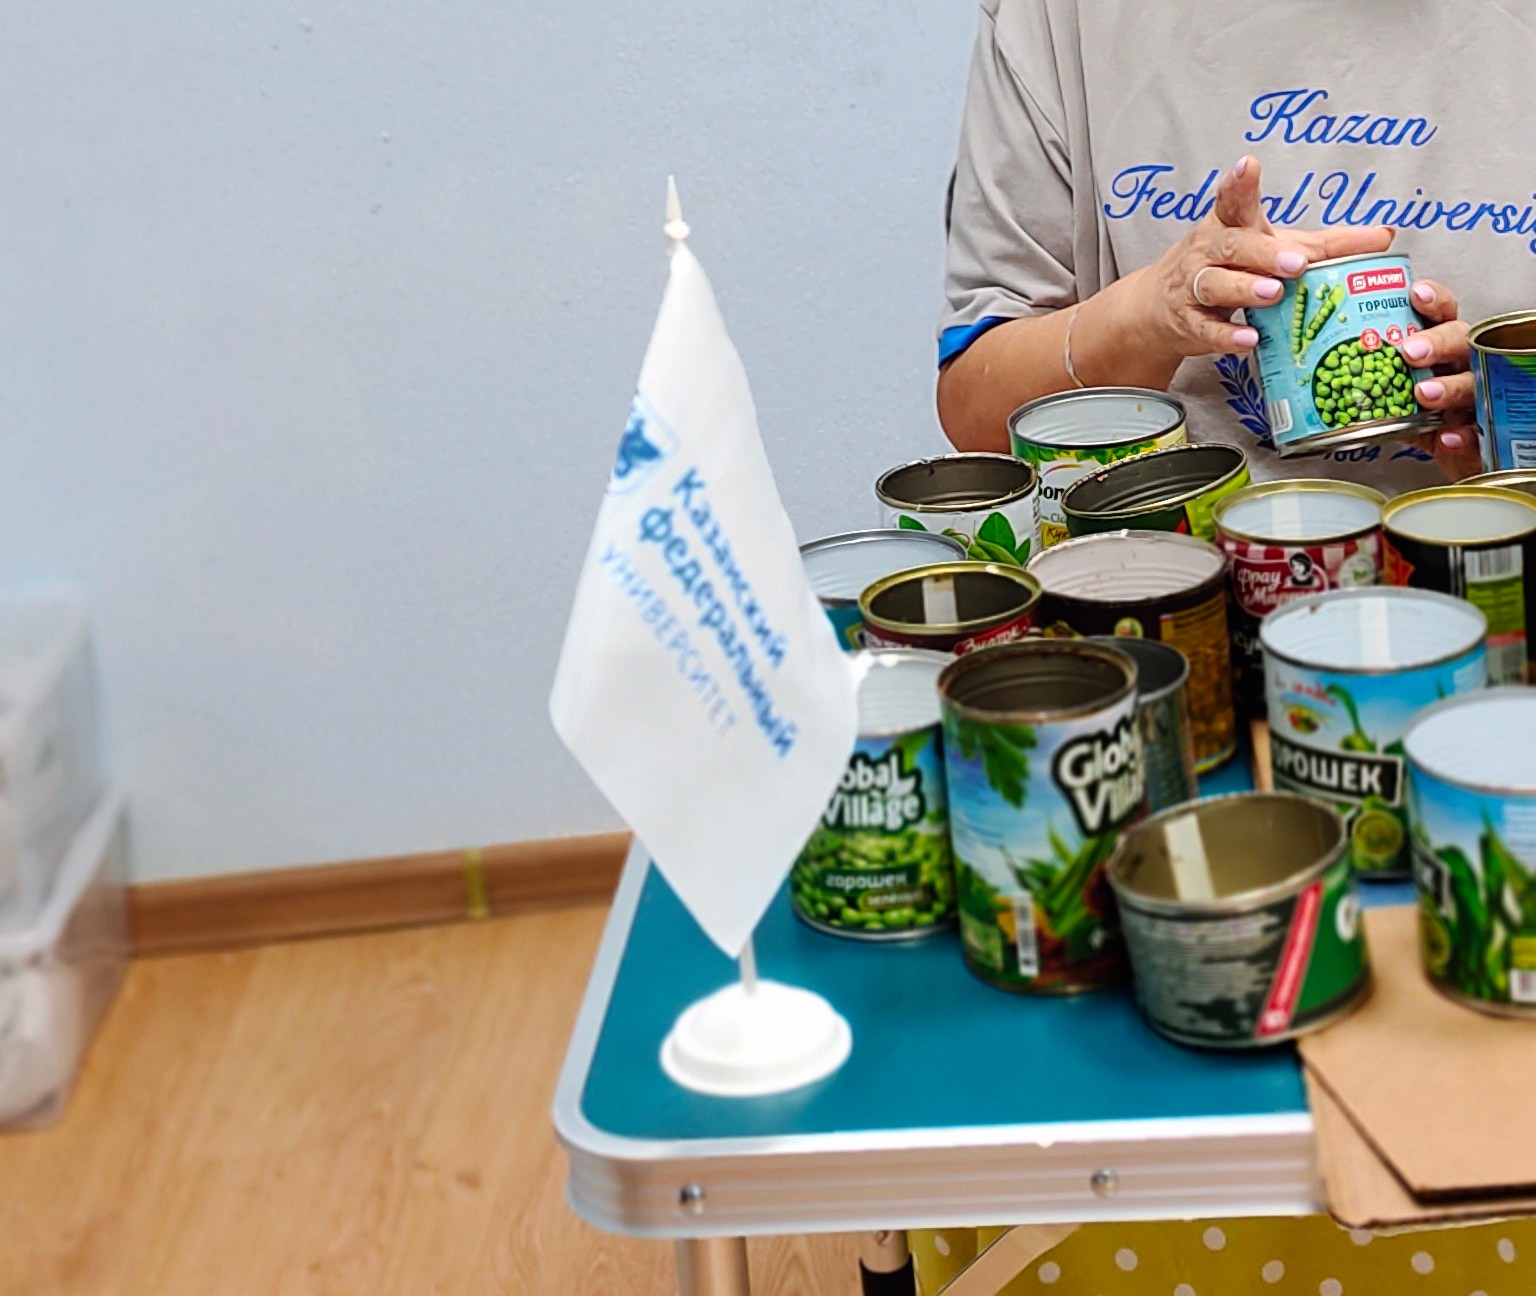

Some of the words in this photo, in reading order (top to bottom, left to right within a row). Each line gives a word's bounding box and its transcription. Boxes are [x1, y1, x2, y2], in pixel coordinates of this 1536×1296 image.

[1245, 88, 1438, 147] Kazan
[1103, 164, 1313, 224] Fedal
[1357, 296, 1410, 313] ГОРОШЕК
[671, 465, 788, 670] Казанский
[598, 536, 738, 738] УНИВЕРСИТЕТ
[638, 505, 799, 761] федеральный
[840, 752, 917, 798] obal
